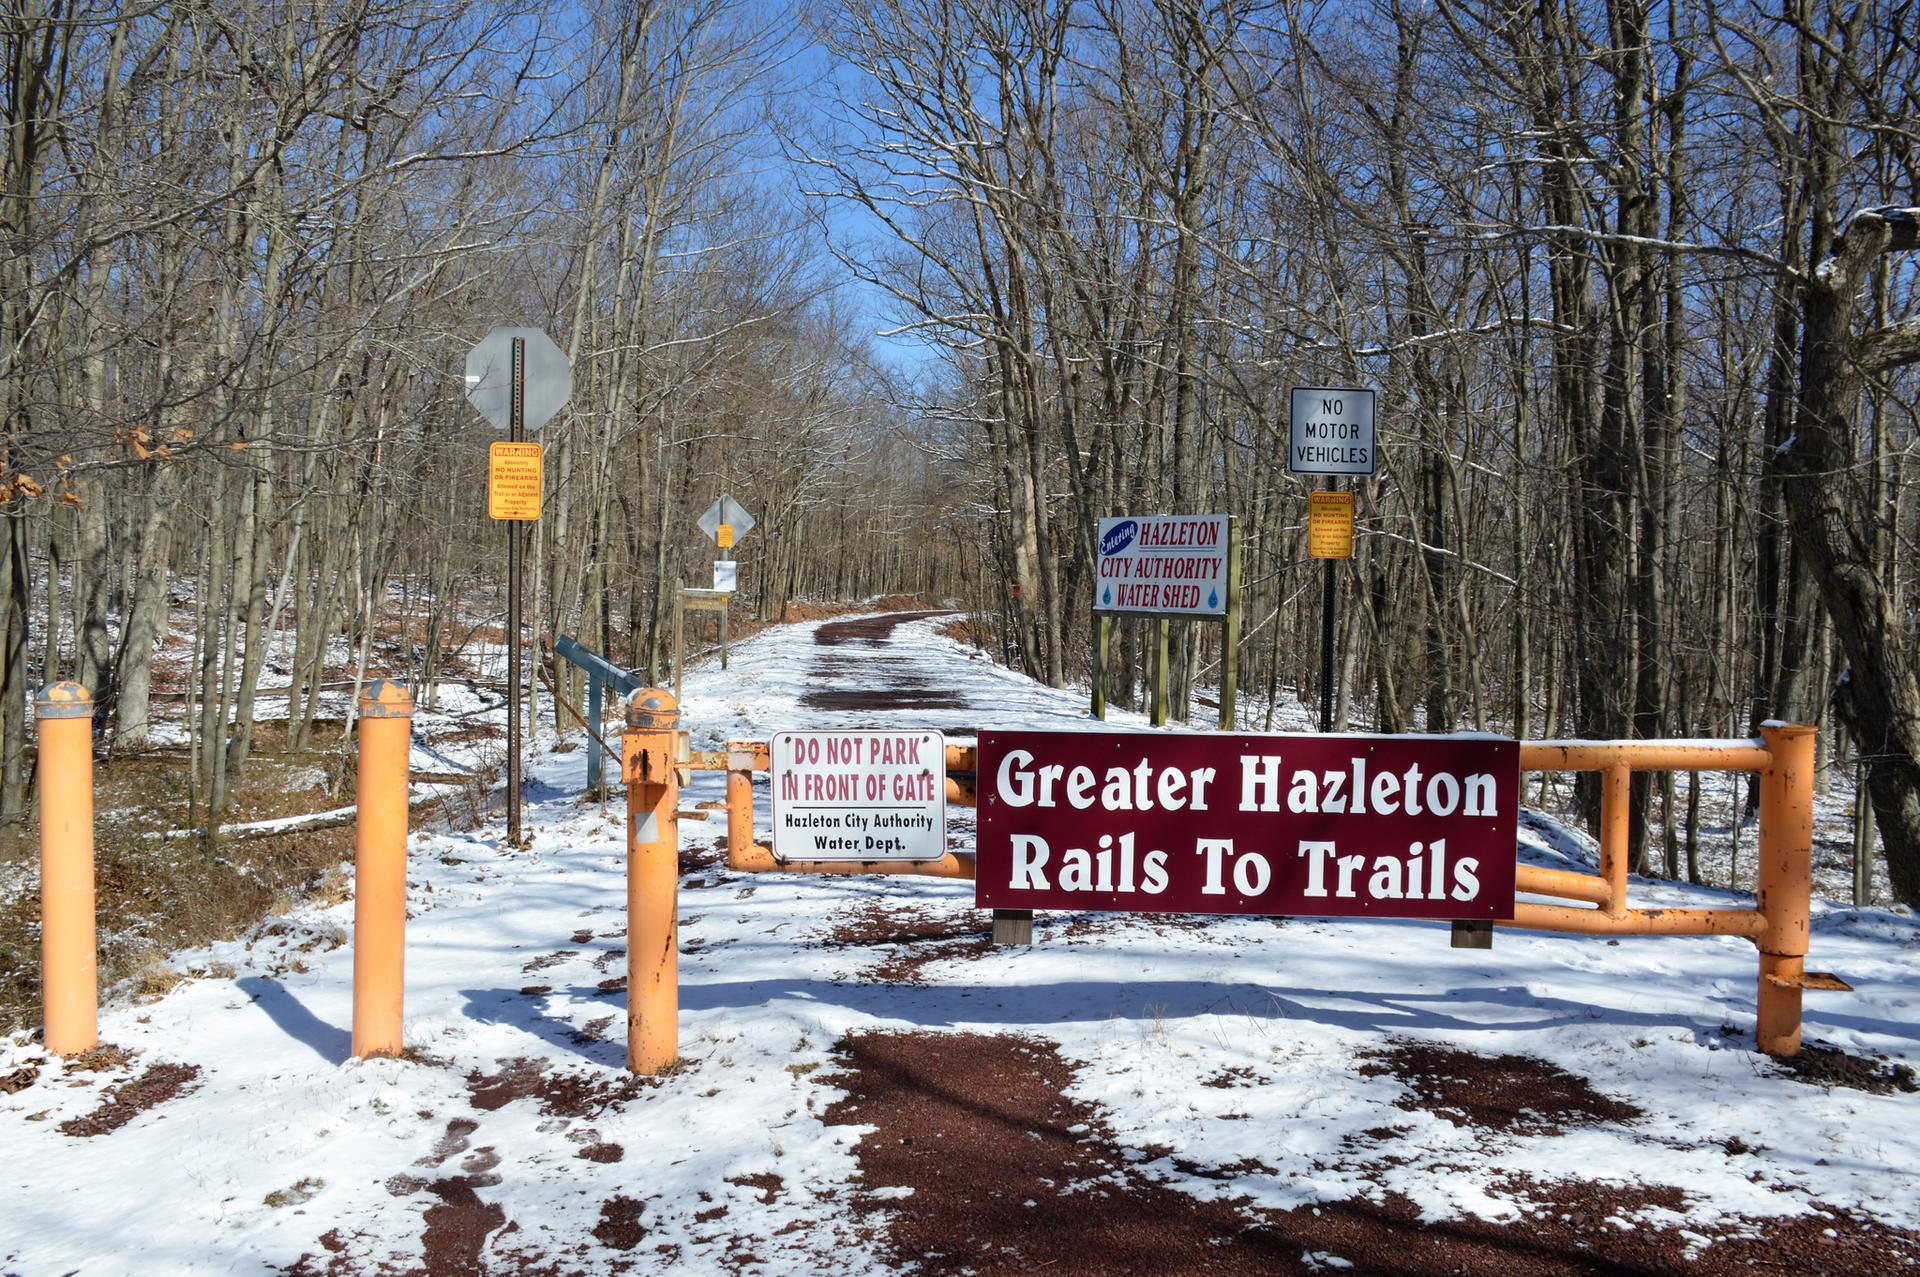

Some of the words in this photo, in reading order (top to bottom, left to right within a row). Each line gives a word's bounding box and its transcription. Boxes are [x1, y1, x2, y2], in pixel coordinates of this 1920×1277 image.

[1322, 399, 1343, 416] NO
[1305, 422, 1359, 440] MOTOR
[495, 448, 538, 457] WARNING
[1297, 446, 1368, 464] VEHICLES
[1313, 496, 1350, 504] WARNING
[1100, 523, 1136, 554] Entering
[1139, 521, 1220, 546] HAZLETON
[1101, 557, 1133, 578] CITY
[1134, 557, 1222, 579] AUTHORITY
[1117, 584, 1160, 607] WATER
[1162, 584, 1200, 608] SHED
[795, 738, 819, 765] DO
[827, 738, 862, 765] NOT
[870, 738, 921, 765] PARK
[782, 774, 798, 801] IN
[805, 774, 859, 801] FRONT
[866, 774, 886, 801] OF
[893, 773, 935, 802] GATE
[997, 749, 1217, 813] Greater
[1238, 755, 1498, 818] Hazleton
[785, 813, 840, 828] Hazleton
[845, 813, 868, 831] City
[874, 813, 933, 831] Authority
[814, 836, 860, 850] Water
[865, 836, 906, 853] Dept.
[1009, 832, 1169, 895] Rails
[1196, 838, 1272, 897] To
[1299, 838, 1480, 902] Trails
